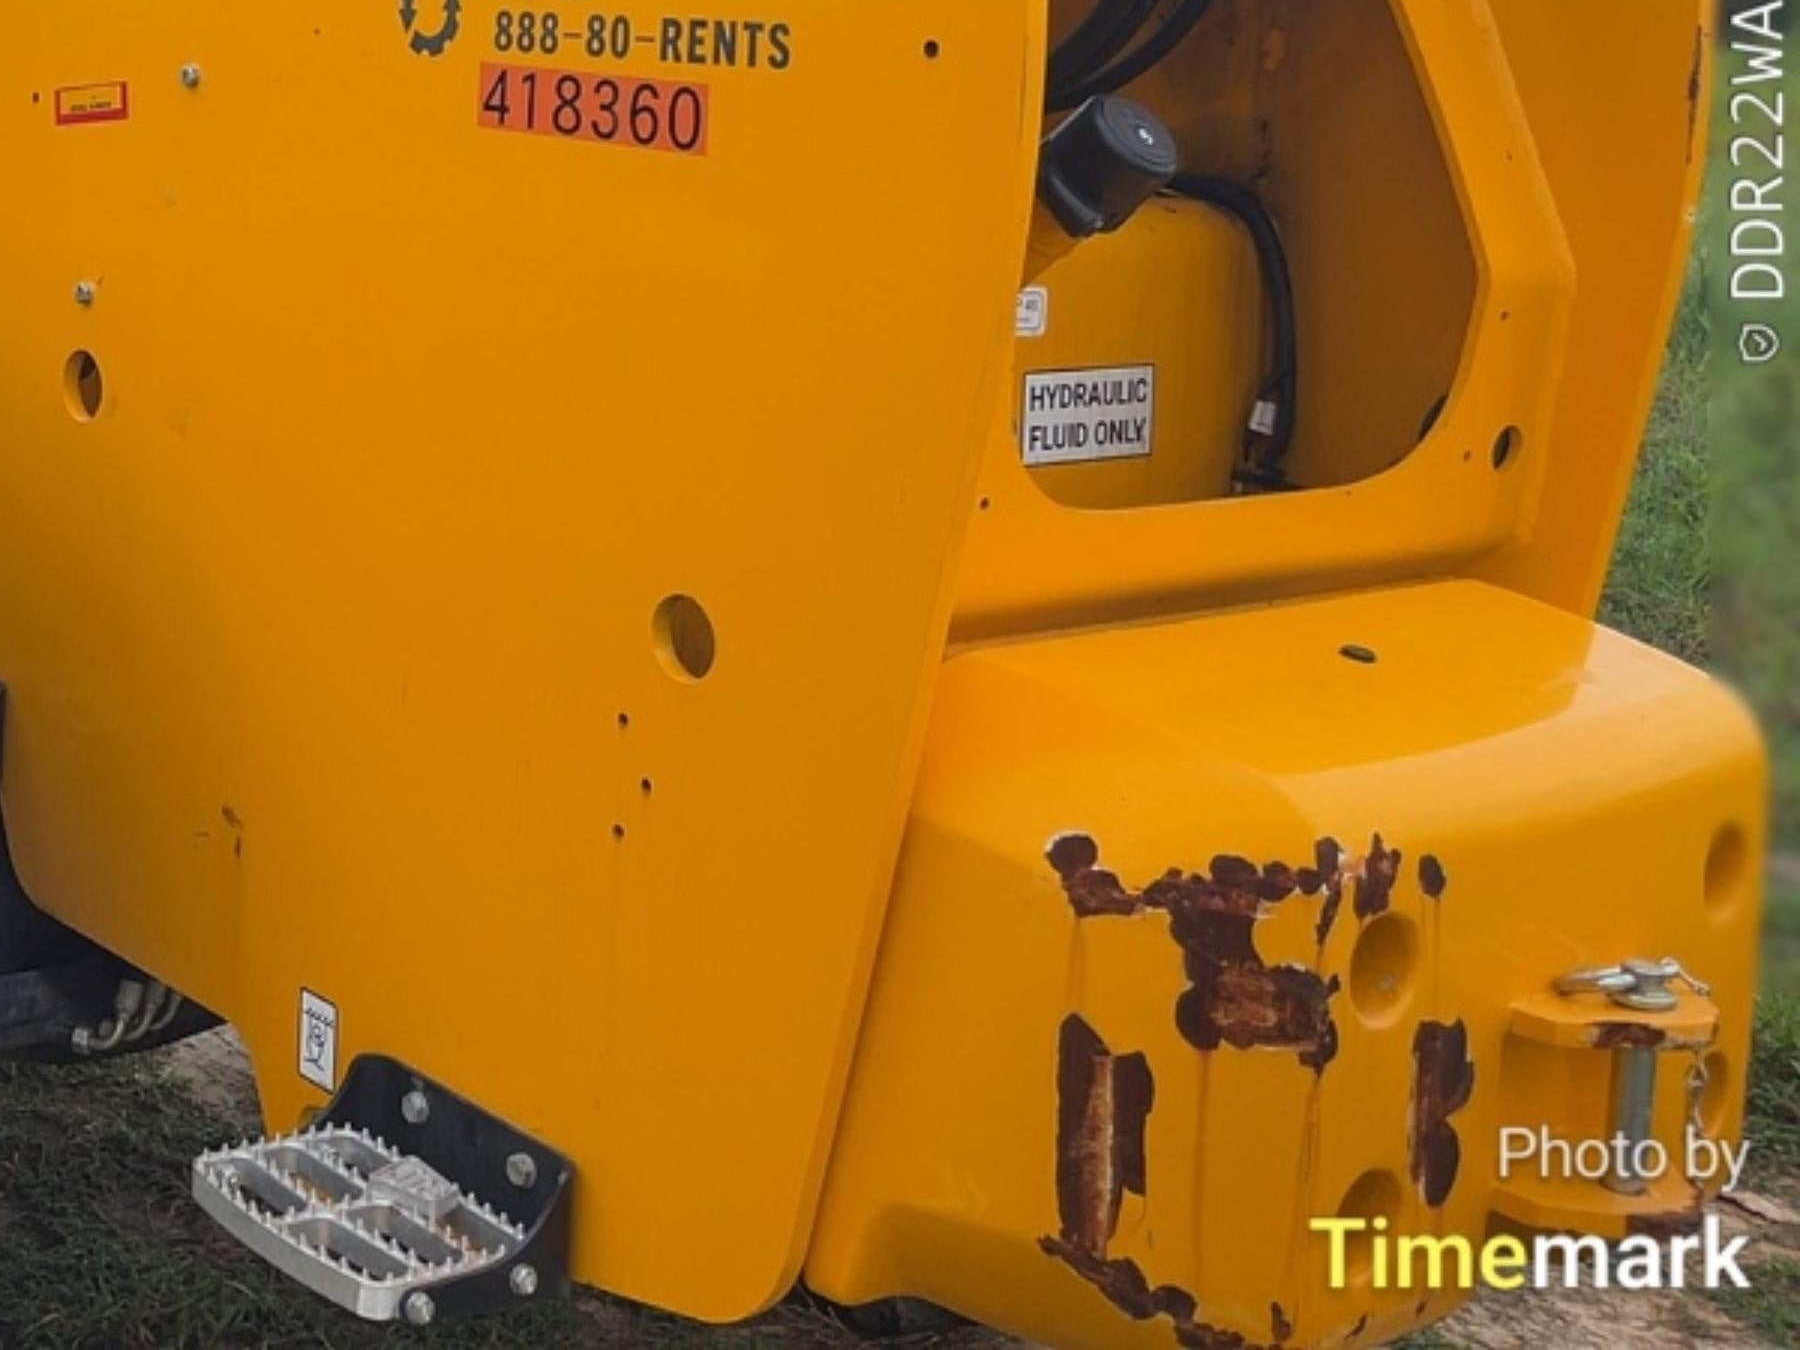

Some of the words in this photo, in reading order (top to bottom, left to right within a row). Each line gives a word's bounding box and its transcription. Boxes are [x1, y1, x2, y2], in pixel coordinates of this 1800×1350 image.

[495, 10, 792, 70] 888-80-RENTS
[482, 69, 700, 151] 418360
[1030, 378, 1147, 411] HYDRAULIC
[1029, 422, 1088, 451] FLUID
[1095, 418, 1146, 445] ONLY
